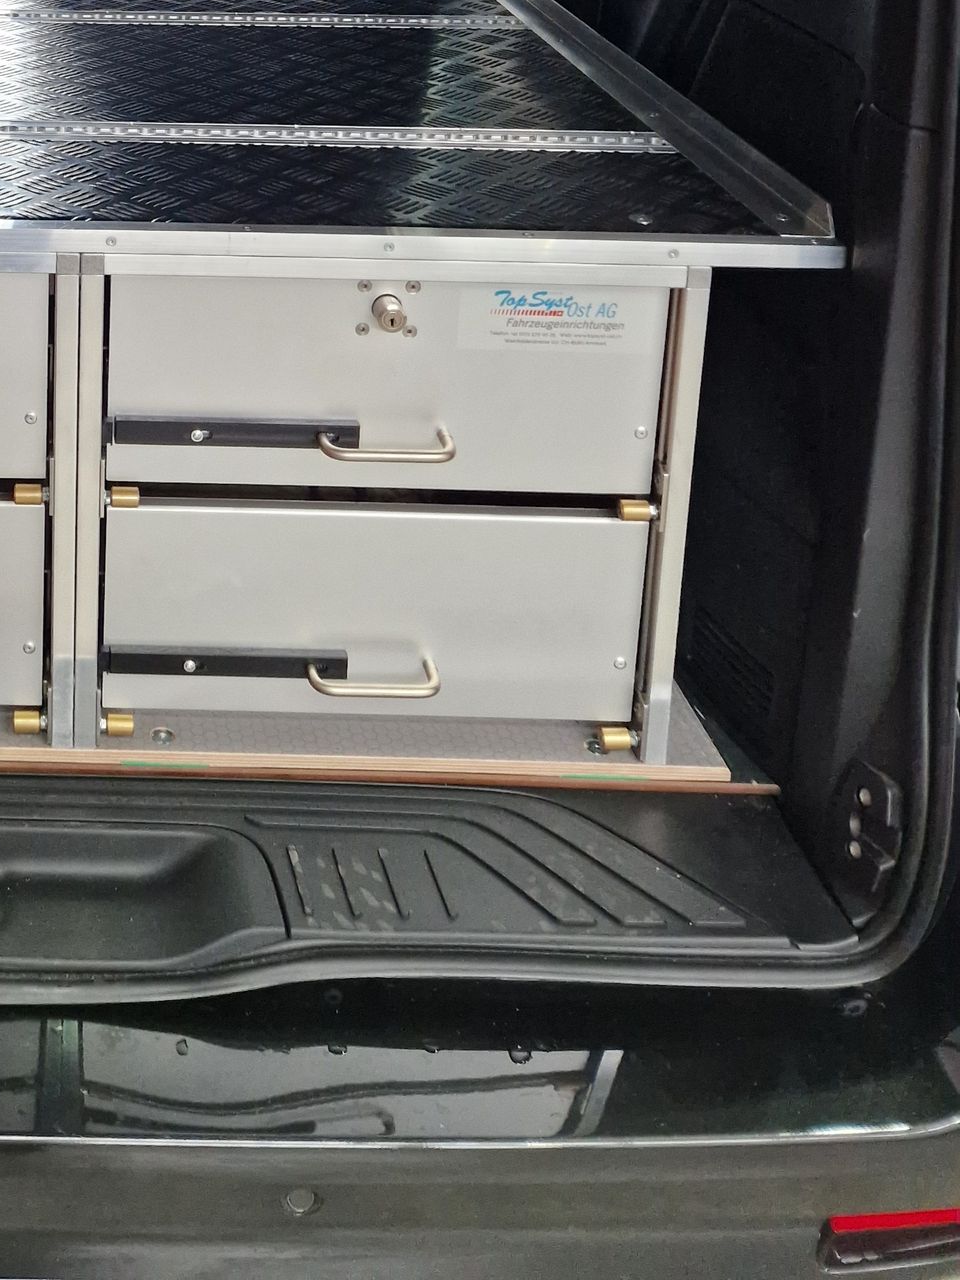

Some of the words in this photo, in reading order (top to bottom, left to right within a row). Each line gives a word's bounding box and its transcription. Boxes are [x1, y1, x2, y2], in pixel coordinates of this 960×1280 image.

[567, 301, 592, 318] Ost
[596, 303, 619, 319] AG
[505, 318, 625, 331] Fahrzeugeinrichtungen
